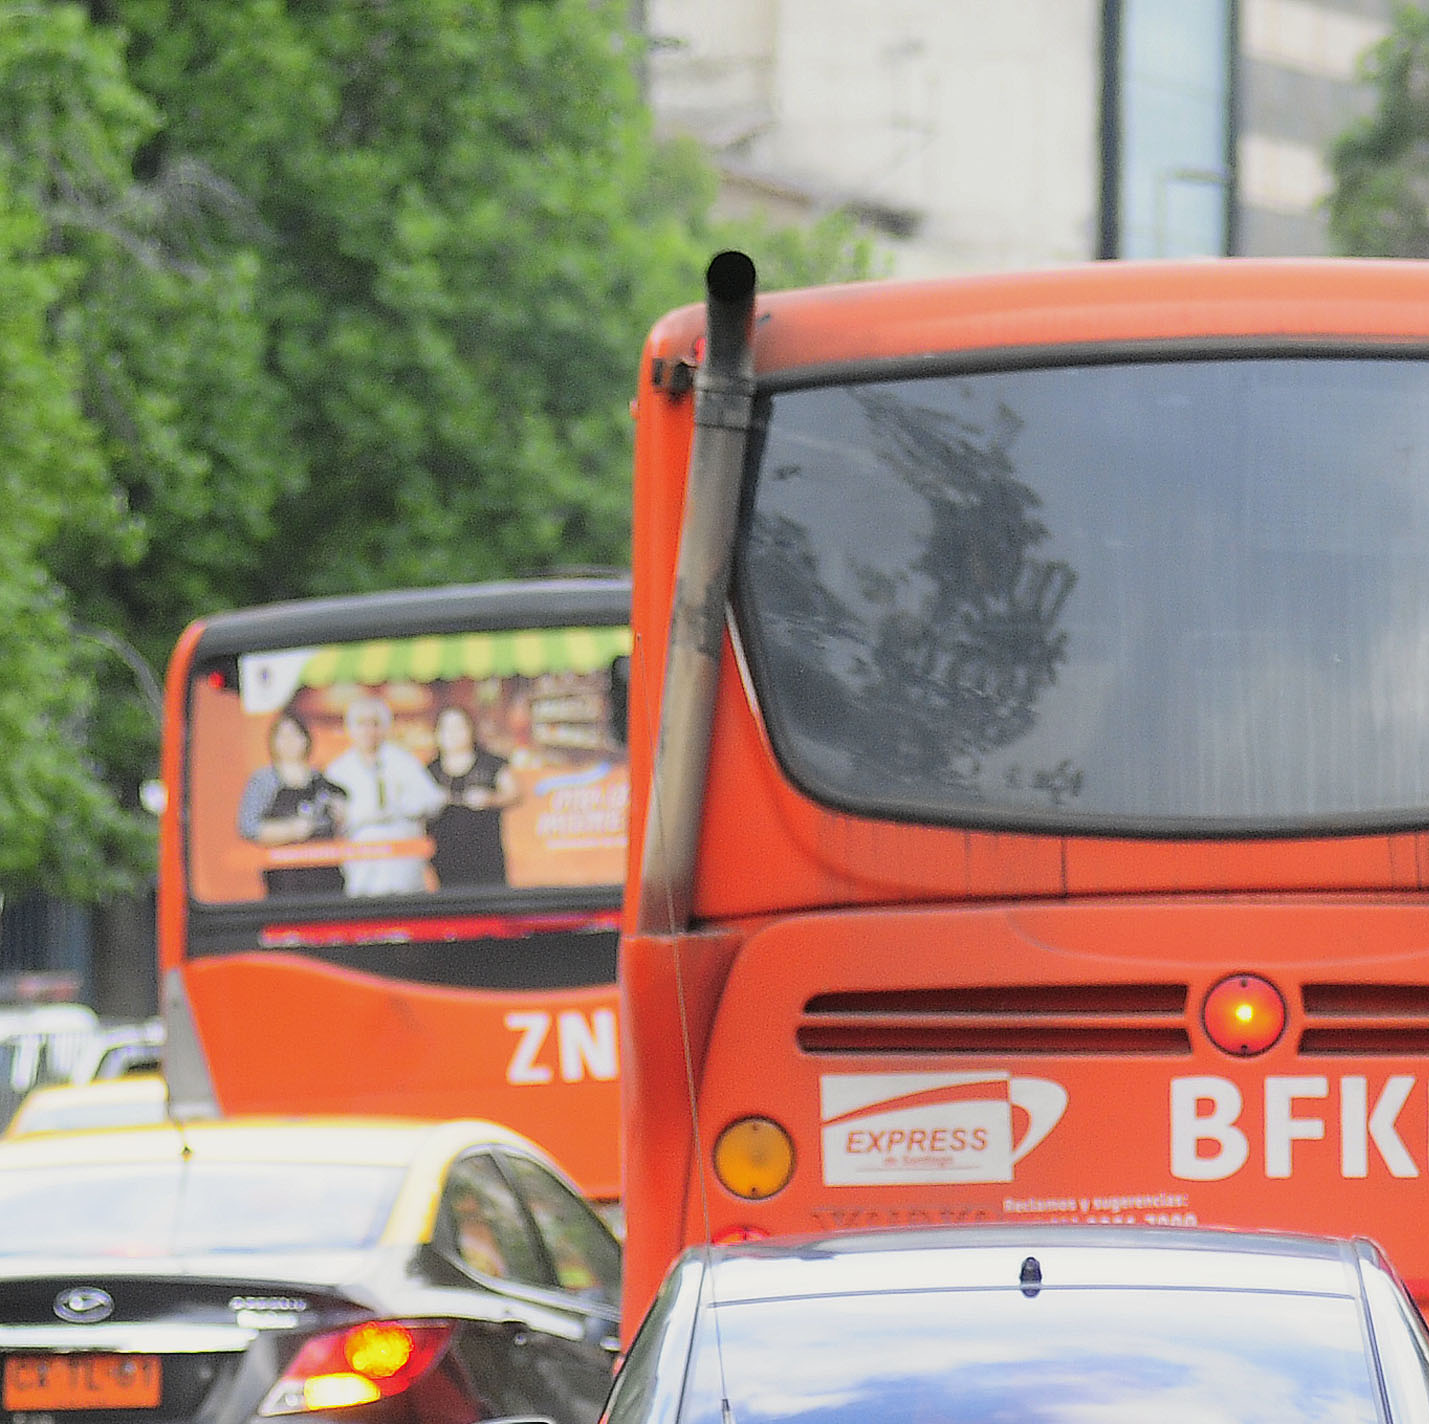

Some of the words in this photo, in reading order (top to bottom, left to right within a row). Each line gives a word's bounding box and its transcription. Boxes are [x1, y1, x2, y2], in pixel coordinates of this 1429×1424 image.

[505, 1009, 620, 1084] ZN
[845, 1127, 989, 1154] EXPRESS
[1003, 1198, 1078, 1213] Reclamos
[1079, 1198, 1090, 1213] y
[1093, 1192, 1189, 1213] sugerencias:
